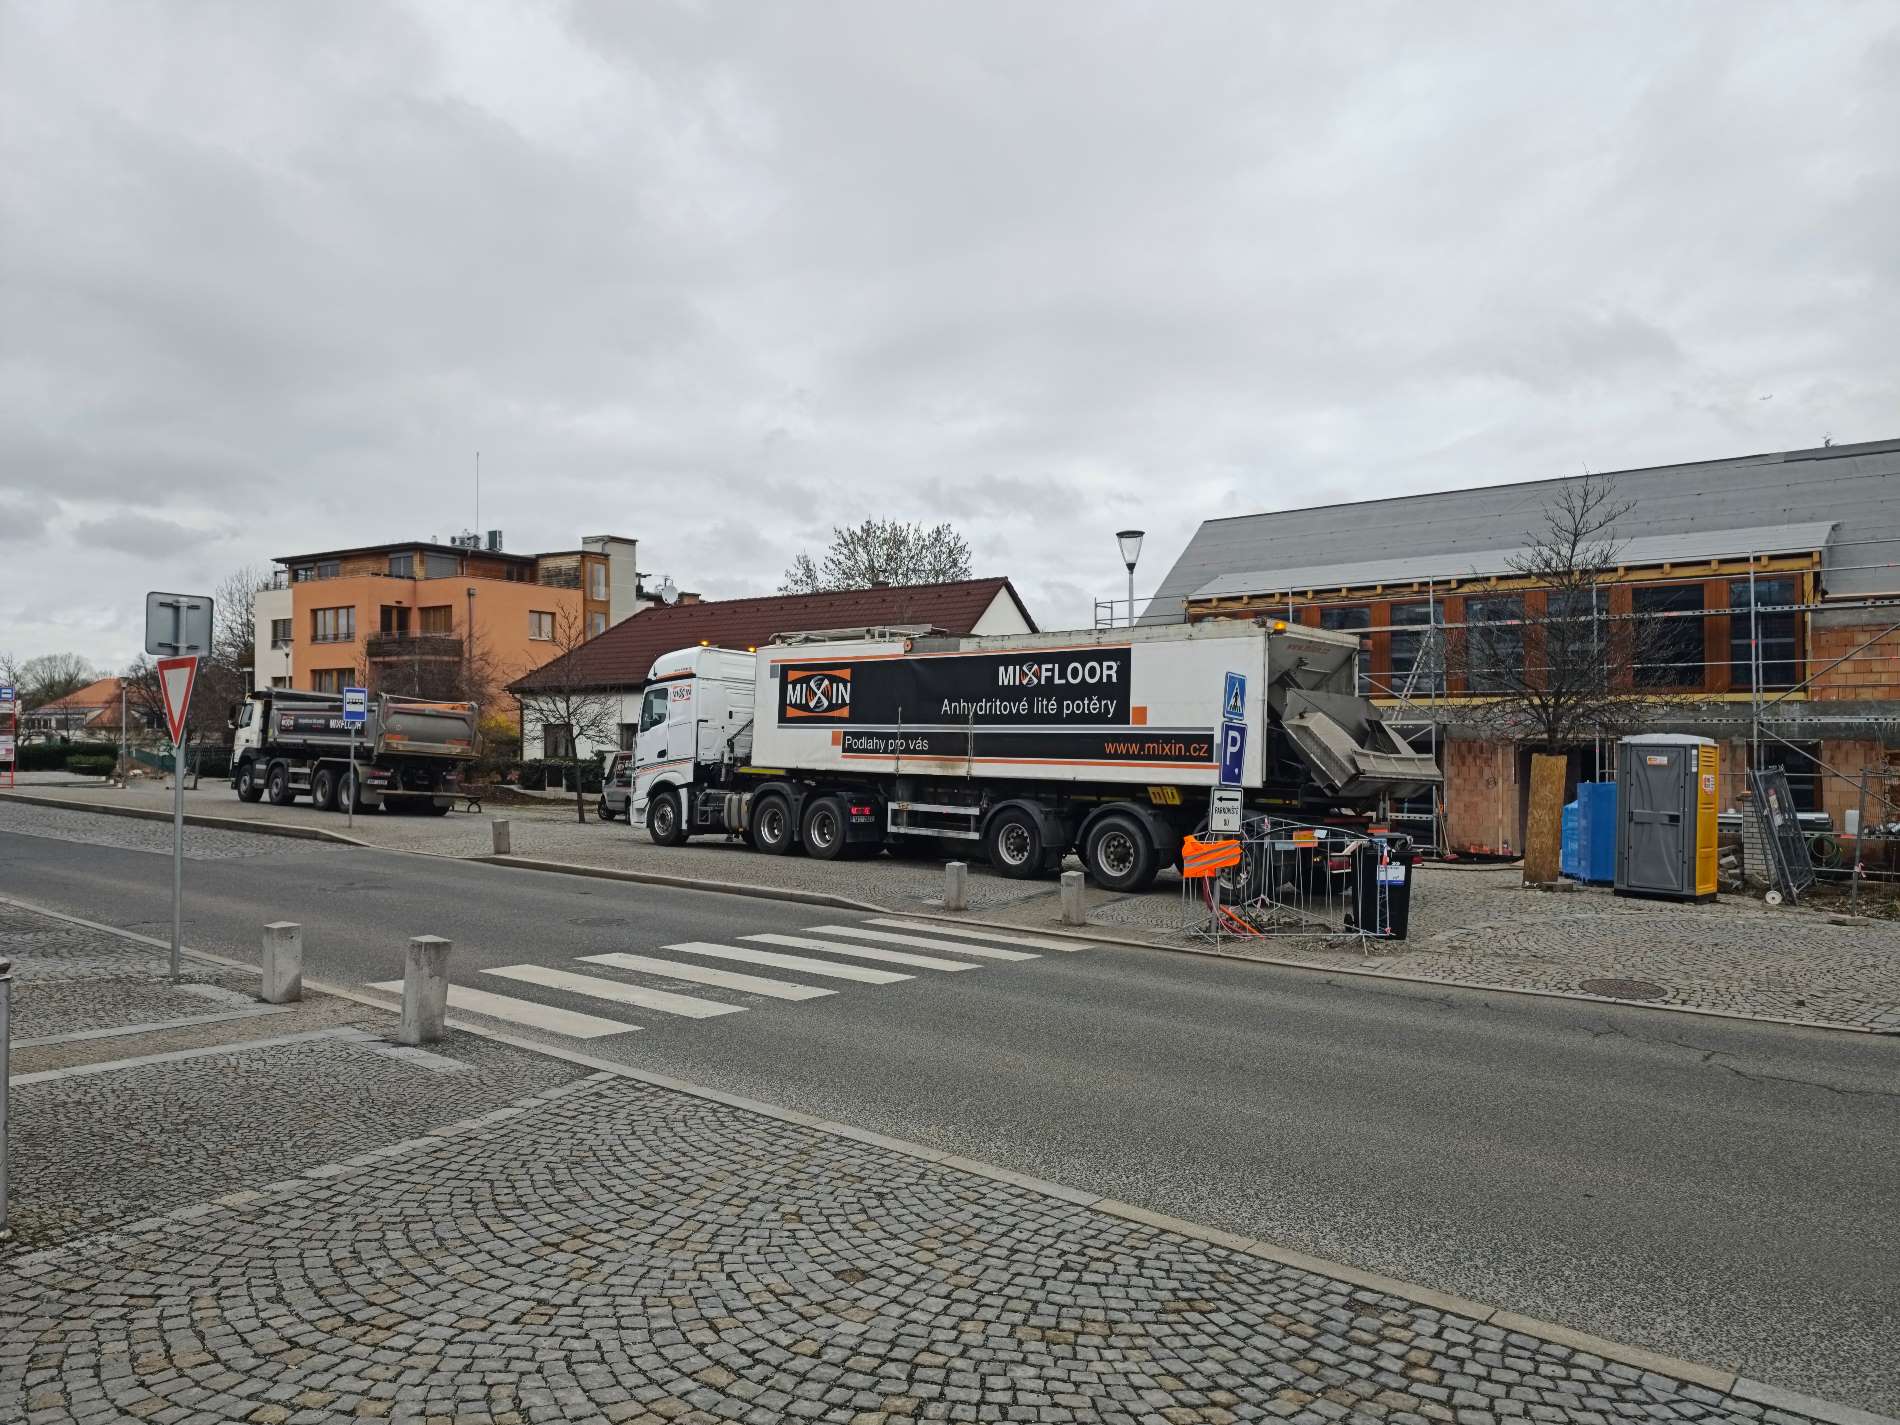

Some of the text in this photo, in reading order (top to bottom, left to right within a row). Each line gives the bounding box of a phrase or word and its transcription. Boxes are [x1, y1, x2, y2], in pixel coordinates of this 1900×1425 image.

[998, 661, 1118, 687] MIXFLOOR
[786, 677, 851, 710] MIXIN
[941, 695, 1117, 718] Anhydritové lité potěry
[845, 736, 929, 753] Podlahy pro vás
[1104, 739, 1209, 756] www.mixin.cz
[1226, 730, 1241, 766] P
